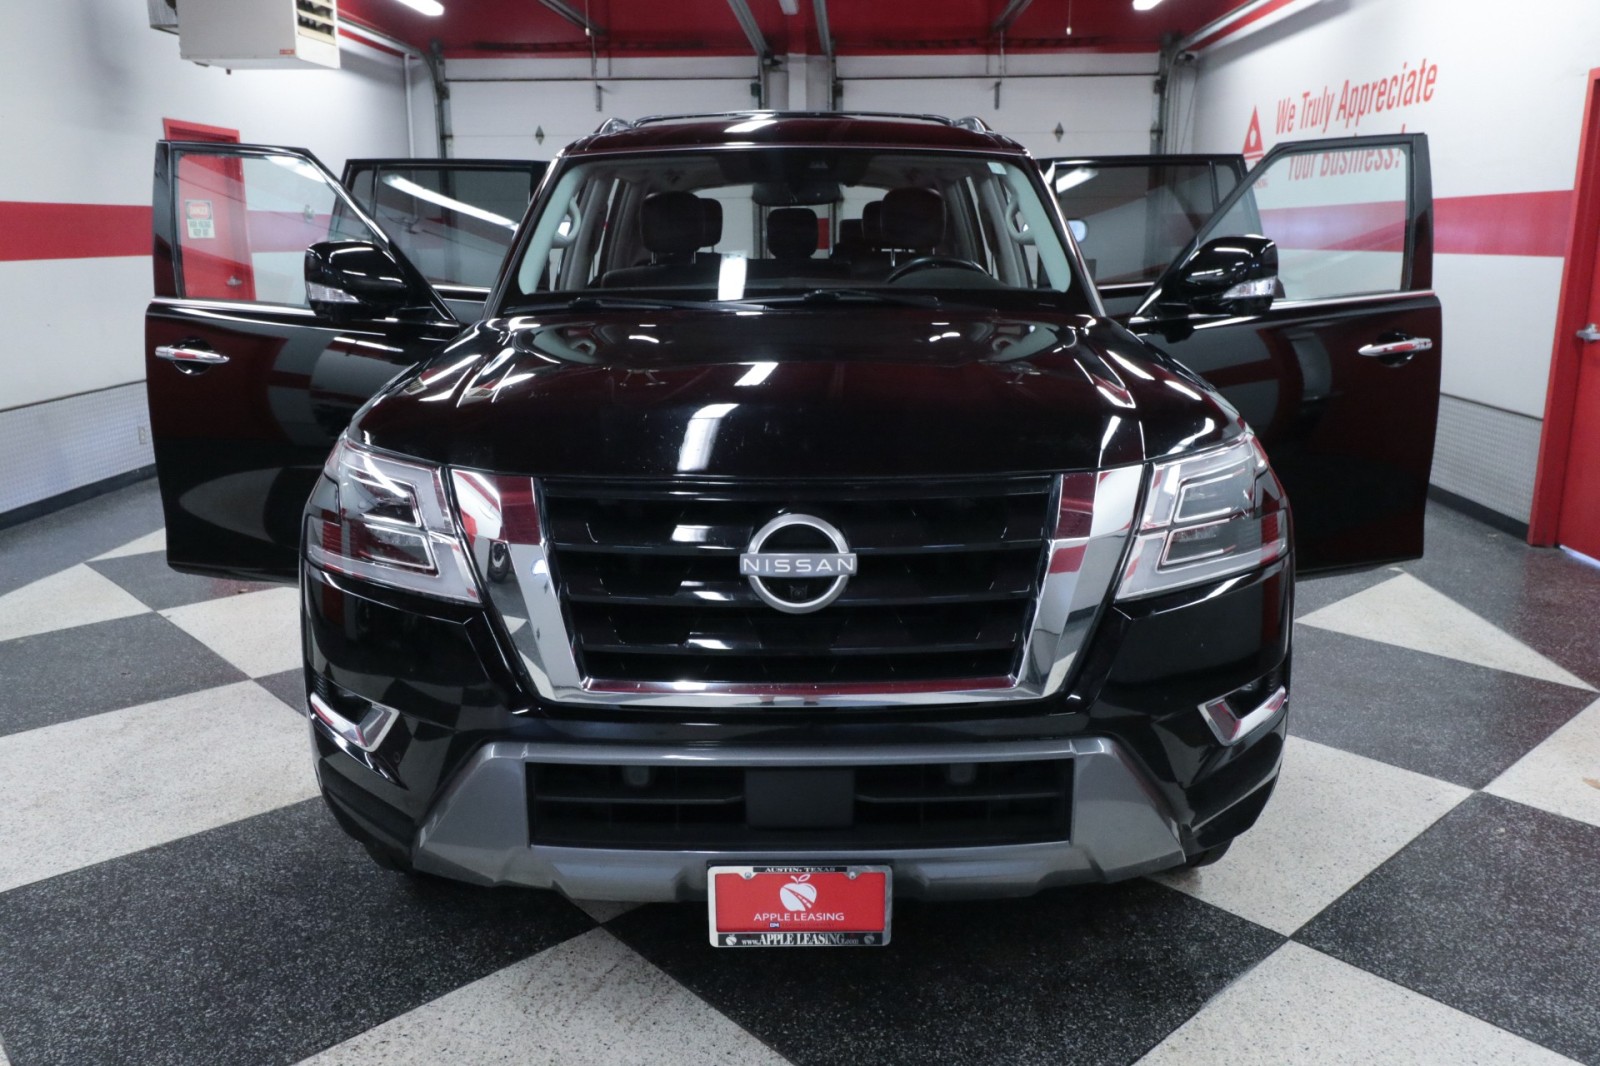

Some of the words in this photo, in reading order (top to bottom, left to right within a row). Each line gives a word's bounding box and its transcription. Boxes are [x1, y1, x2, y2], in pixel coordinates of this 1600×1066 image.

[1276, 96, 1296, 134] We
[1299, 85, 1335, 134] Truly
[1335, 58, 1438, 129] Appreciate
[743, 558, 854, 573] NISSAN
[753, 912, 791, 921] APPLE
[793, 912, 845, 921] LEASING
